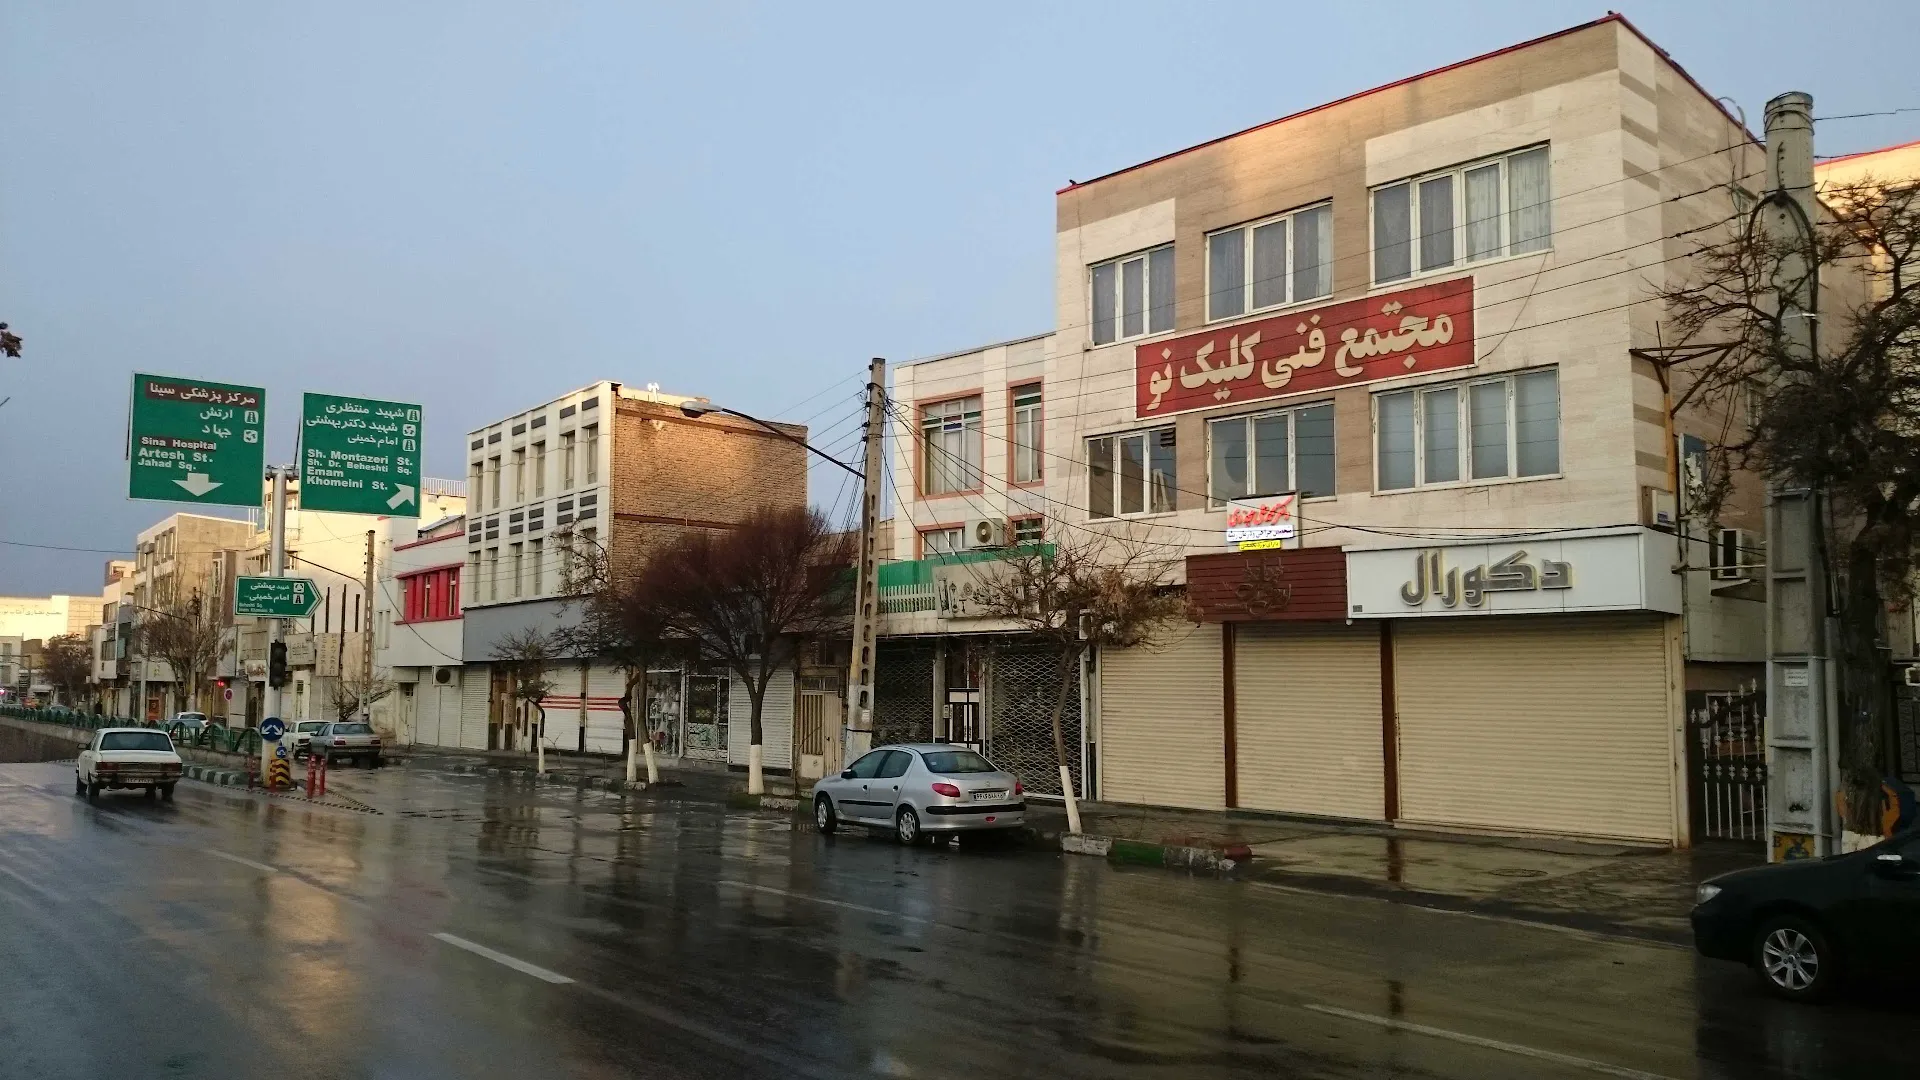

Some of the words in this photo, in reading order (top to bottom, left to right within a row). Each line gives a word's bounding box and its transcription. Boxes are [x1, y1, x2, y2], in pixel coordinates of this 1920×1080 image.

[1334, 301, 1454, 378] مجتمع
[1261, 314, 1326, 389] فنی
[1180, 330, 1261, 402] کلیک
[1146, 347, 1173, 411] نو
[150, 382, 175, 396] سینا
[180, 387, 222, 404] پزشکی
[225, 392, 256, 405] مرکز
[199, 406, 233, 420] ارتش
[325, 402, 369, 415] منتظری
[375, 407, 404, 420] شهید
[306, 414, 342, 429] بهشتی
[368, 422, 398, 434] شهید
[201, 423, 232, 438] جهاد
[141, 436, 166, 447] Sina
[172, 439, 217, 450] Hospital
[347, 433, 377, 444] خمینی
[377, 437, 398, 448] امام
[138, 447, 185, 460] Artesh
[193, 452, 213, 463] St.
[307, 448, 327, 459] Sh.
[330, 450, 389, 464] Montazeri
[397, 456, 413, 466] St.
[137, 457, 172, 468] Jahad
[178, 461, 197, 471] Sq.
[307, 458, 323, 467] Sh.
[328, 459, 342, 468] Dr.
[346, 461, 389, 473] Beheshti
[397, 466, 413, 475] Sq.
[306, 466, 344, 478] Emam
[306, 475, 363, 489] Khomeini
[371, 480, 388, 491] St.
[1400, 549, 1573, 608] دکورال
[250, 581, 276, 591] بهشتی
[249, 593, 273, 601] خمینی
[273, 593, 290, 603] امام
